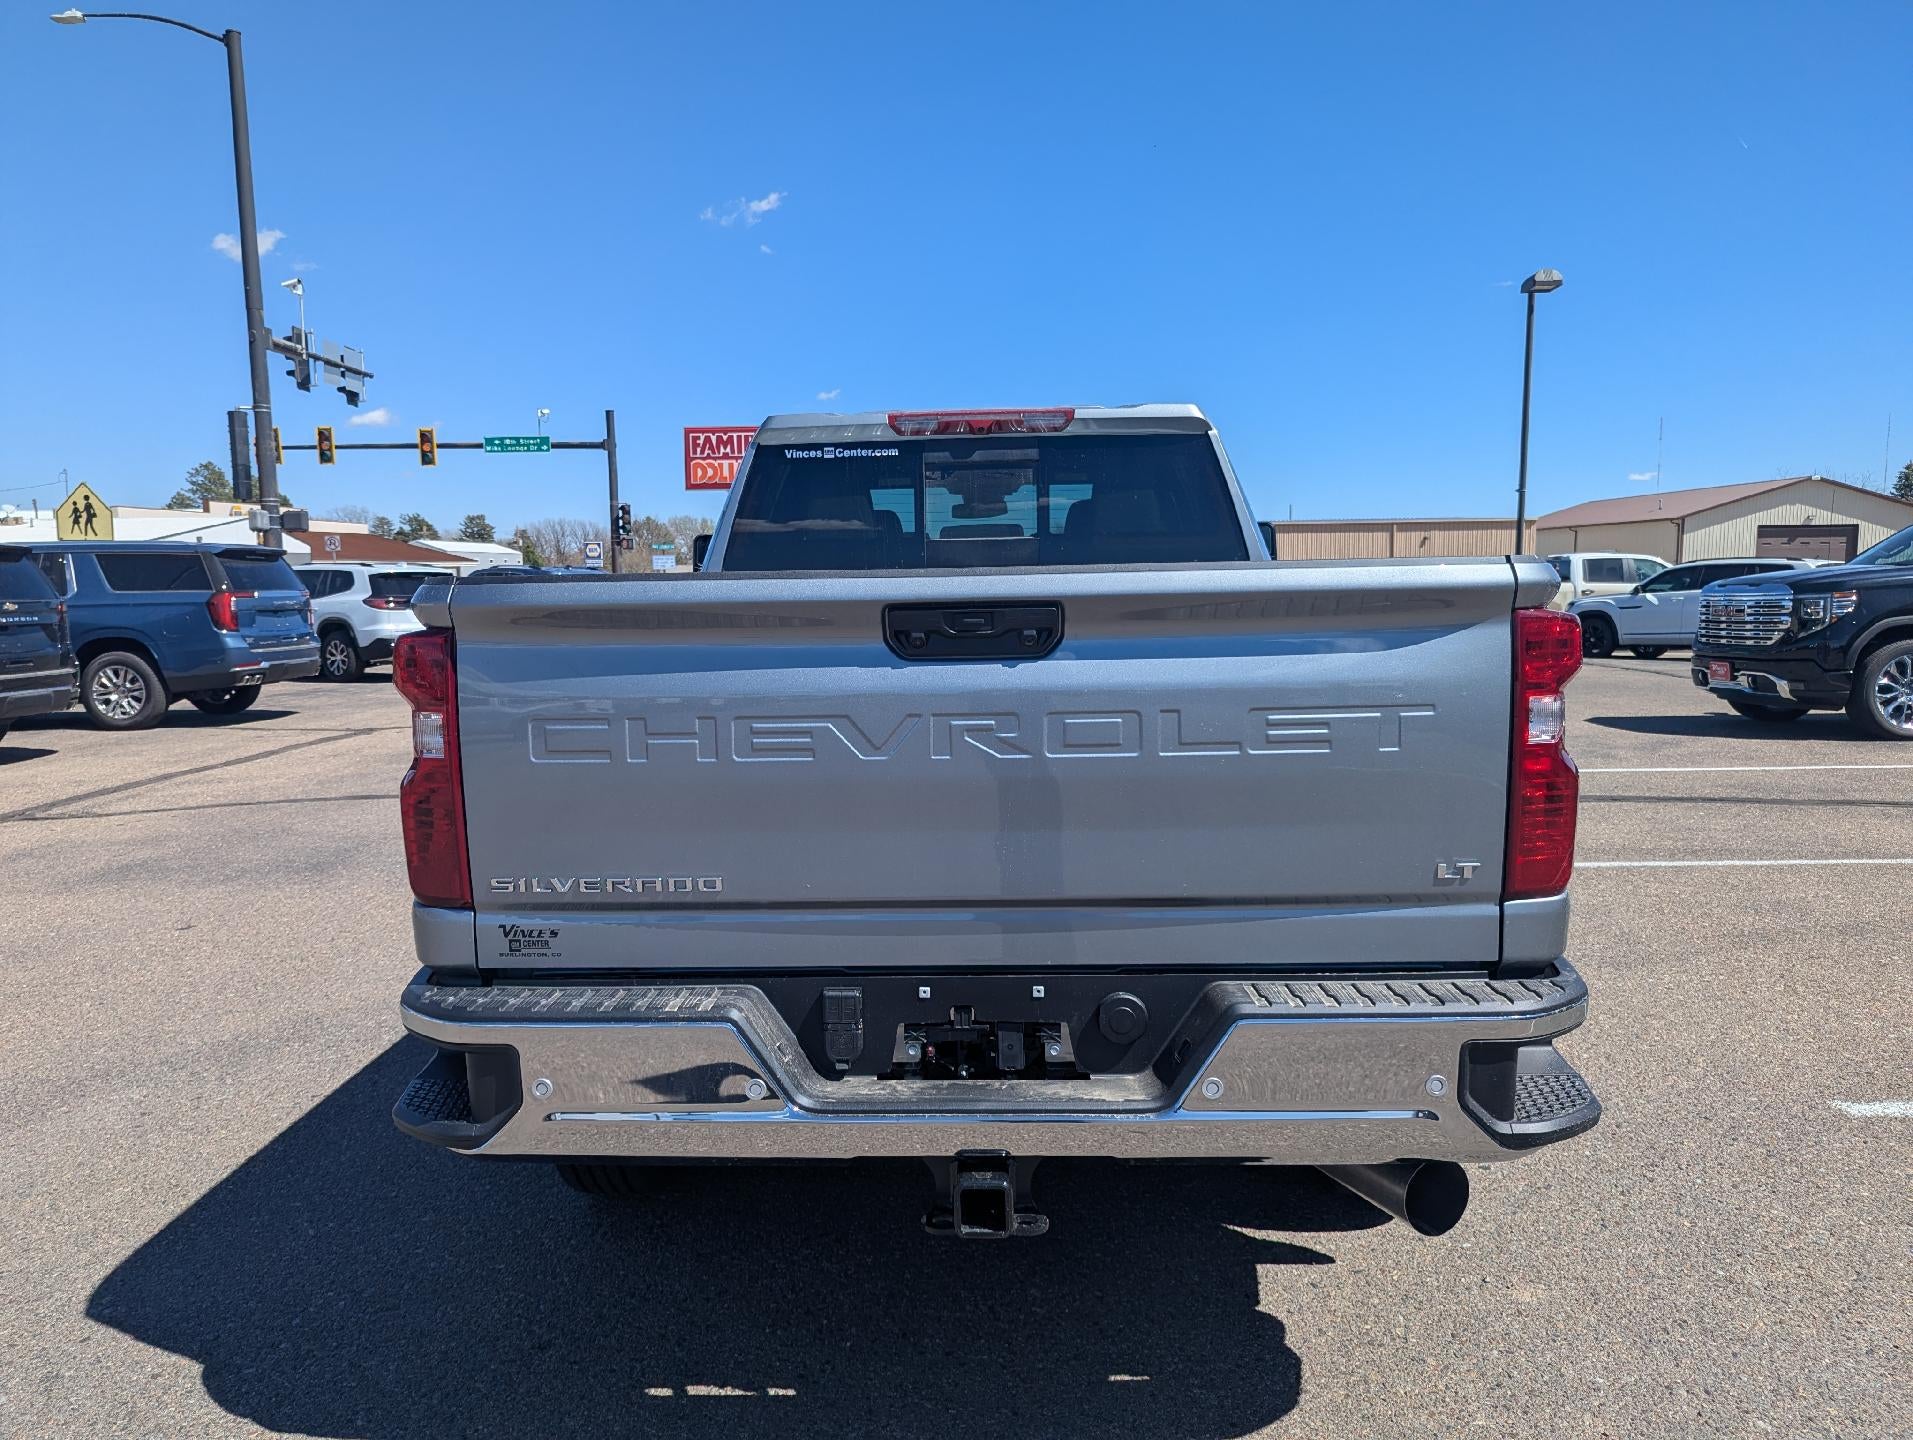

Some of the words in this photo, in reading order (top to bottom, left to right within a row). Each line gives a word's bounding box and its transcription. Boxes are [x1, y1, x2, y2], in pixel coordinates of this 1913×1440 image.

[784, 449, 822, 459] Vinces
[835, 448, 899, 458] Center.com
[1712, 605, 1746, 617] GMC
[527, 704, 1436, 763] CHEVROLET
[1437, 862, 1481, 879] LT
[490, 877, 723, 894] SILVERADO
[522, 940, 550, 948] CENTER
